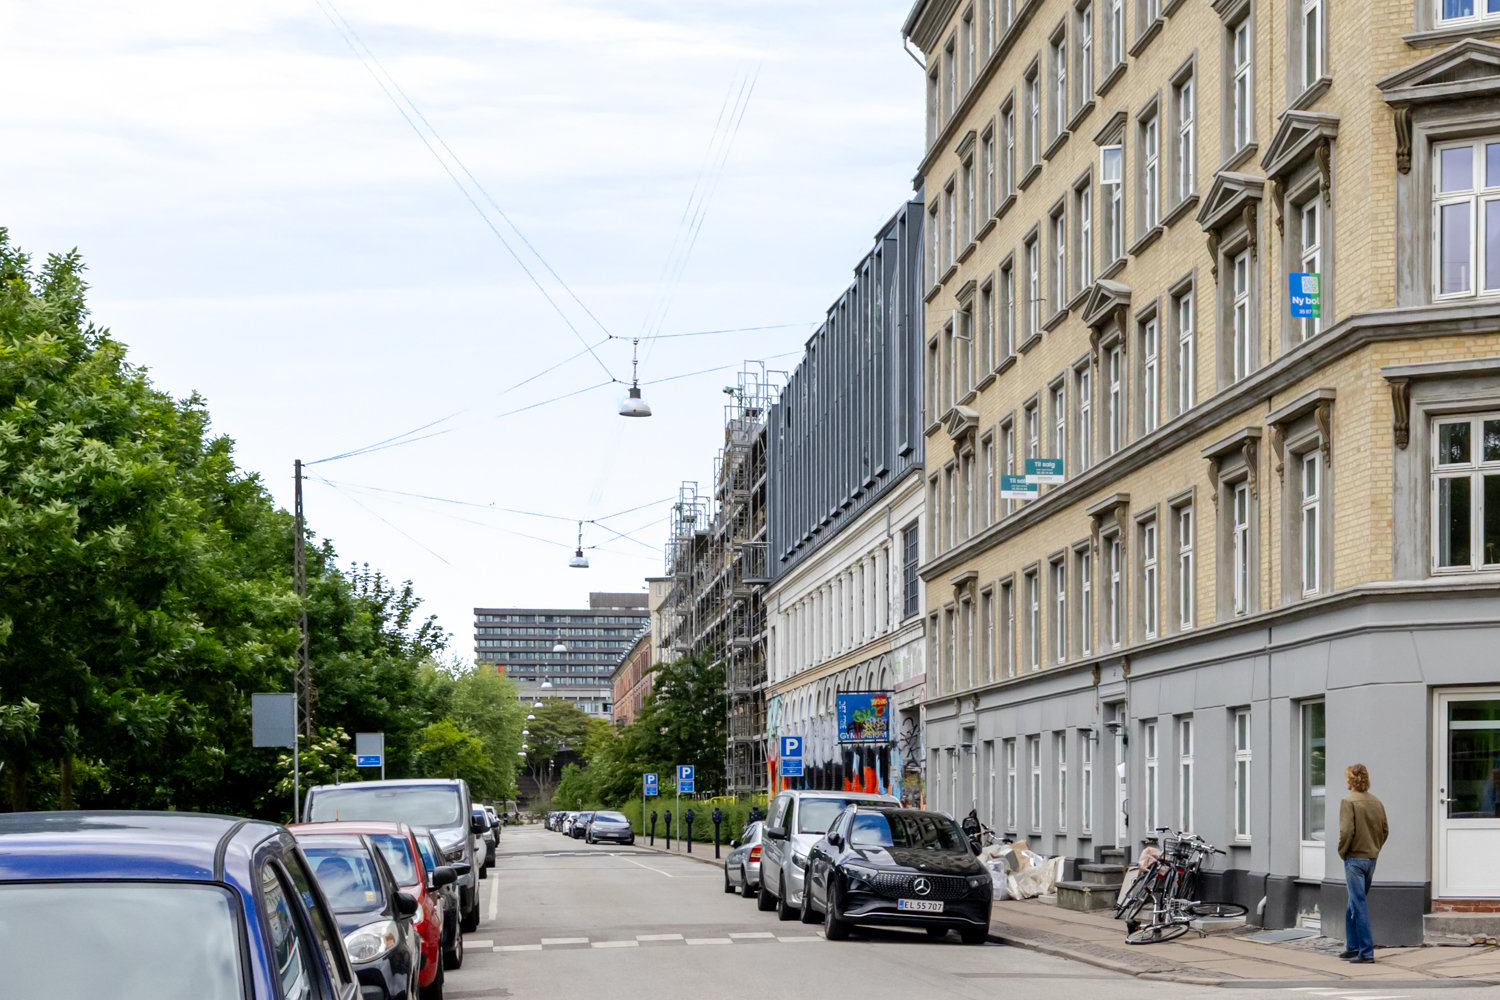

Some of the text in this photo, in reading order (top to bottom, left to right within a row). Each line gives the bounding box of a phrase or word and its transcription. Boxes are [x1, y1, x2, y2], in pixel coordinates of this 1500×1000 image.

[1292, 296, 1304, 306] Ny
[786, 738, 799, 755] P
[682, 767, 691, 778] P
[648, 775, 655, 784] P
[904, 901, 942, 911] EL 55 707
